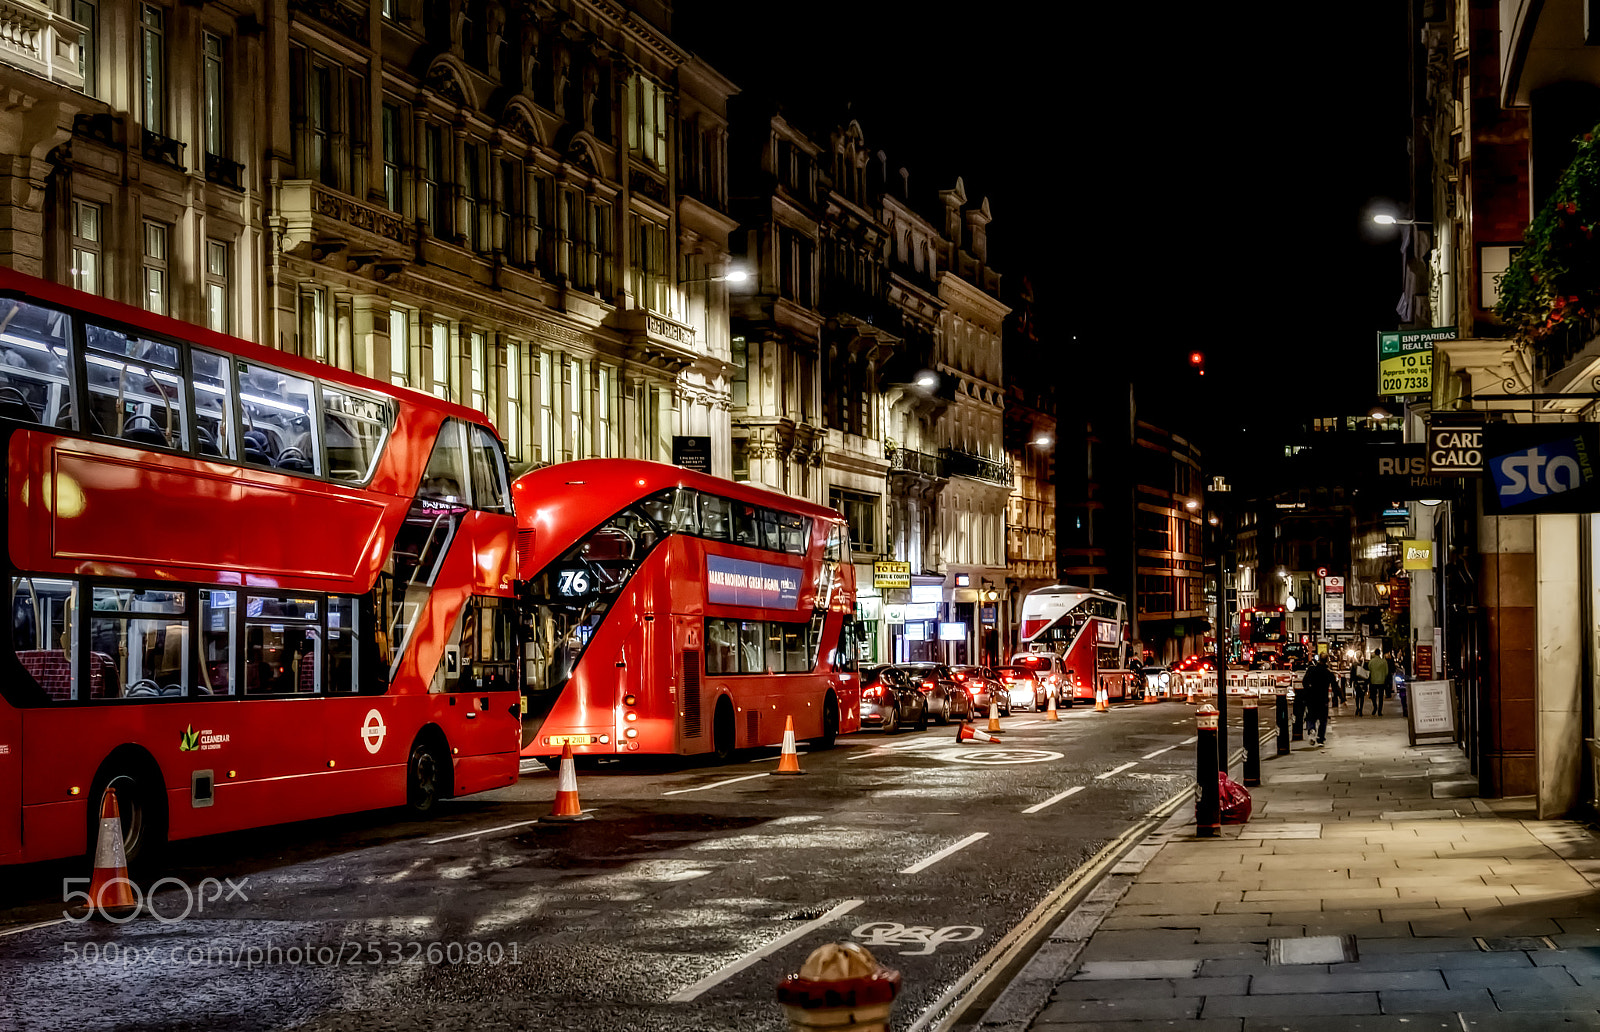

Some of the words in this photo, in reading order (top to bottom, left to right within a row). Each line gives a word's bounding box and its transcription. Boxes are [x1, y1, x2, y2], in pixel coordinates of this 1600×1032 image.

[1402, 335, 1420, 343] BNP
[1421, 332, 1455, 341] PARIBAS
[1401, 356, 1416, 367] TO
[1383, 378, 1402, 390] 020
[1404, 376, 1429, 389] 7338
[1431, 450, 1484, 466] GALO
[1573, 435, 1594, 482] TRAVEL
[1500, 447, 1580, 495] sta
[709, 570, 724, 586] MAKE
[725, 573, 748, 588] MONDAY
[749, 576, 763, 590] GREAT
[764, 578, 780, 591] AGAIN.
[1319, 568, 1326, 577] G
[560, 571, 587, 593] 76
